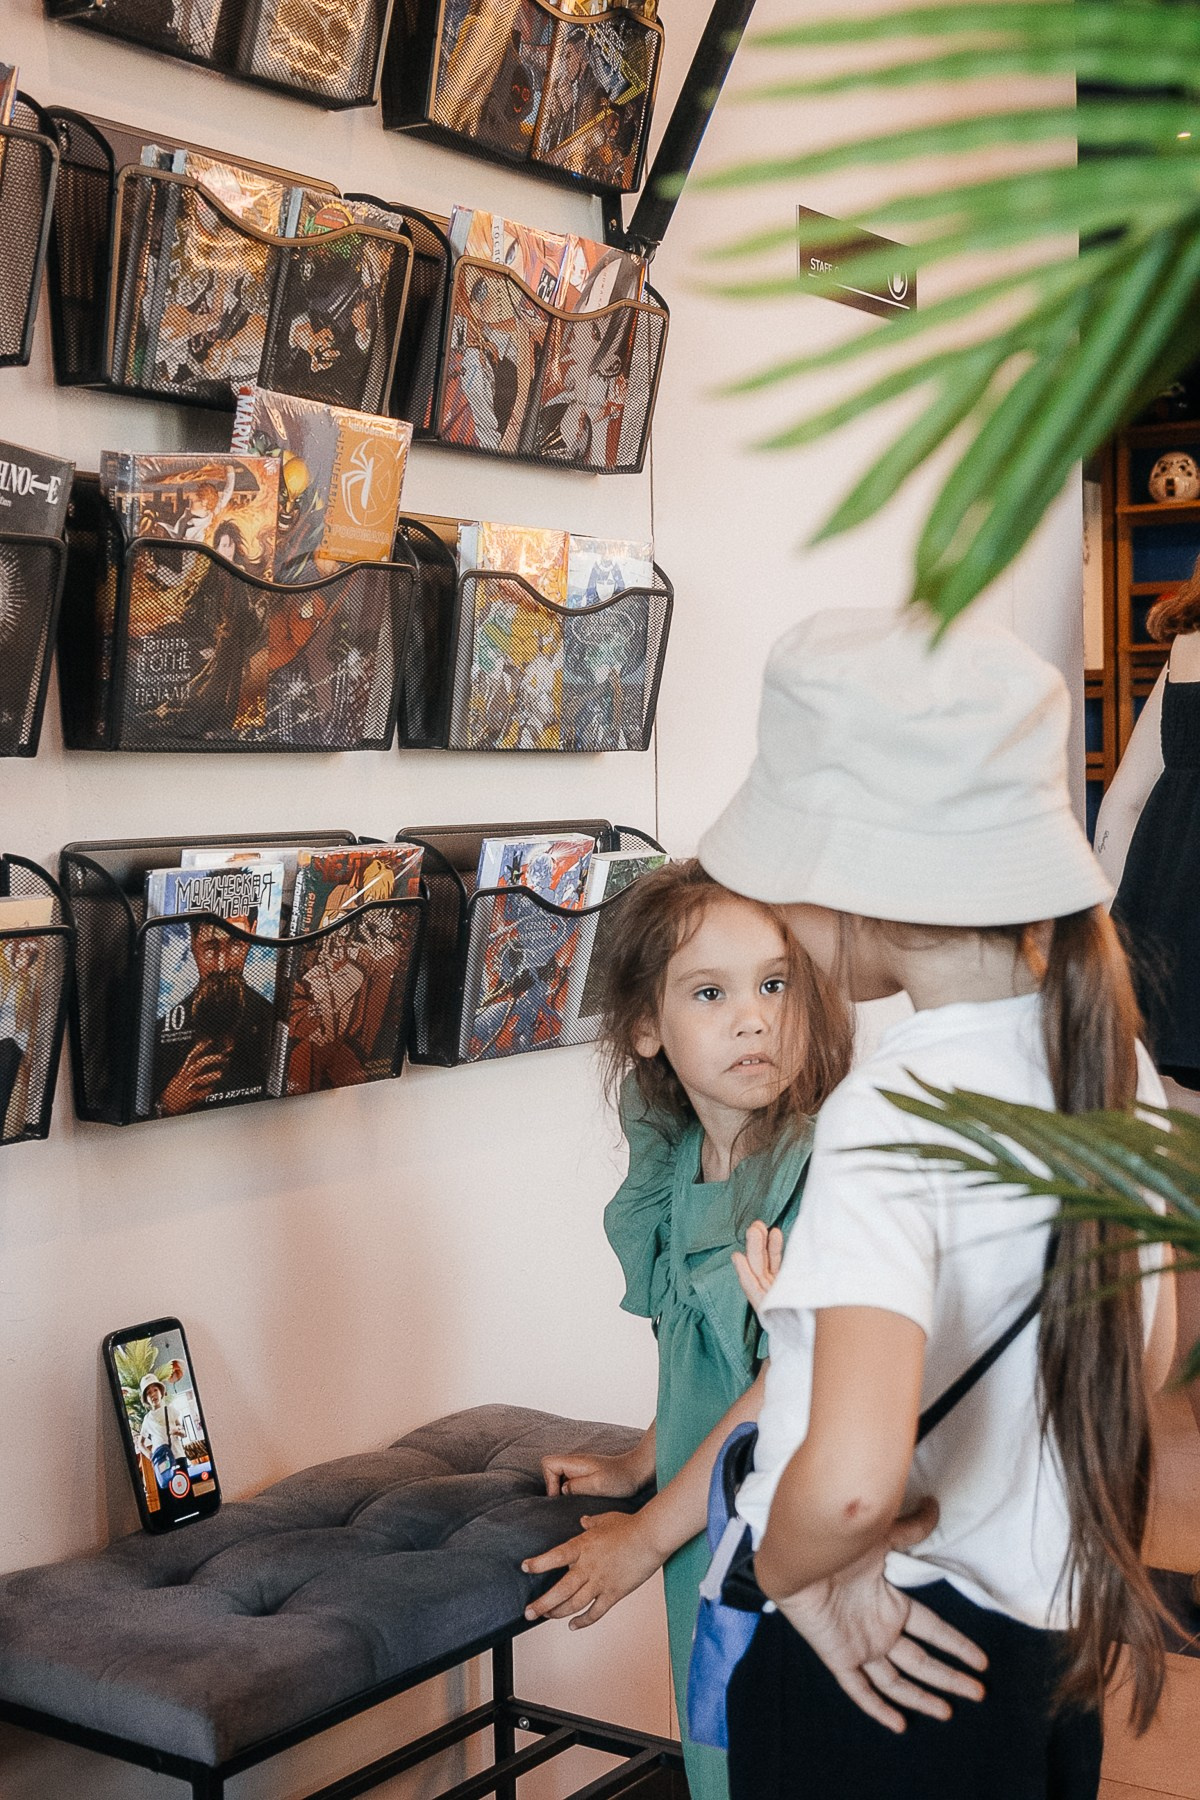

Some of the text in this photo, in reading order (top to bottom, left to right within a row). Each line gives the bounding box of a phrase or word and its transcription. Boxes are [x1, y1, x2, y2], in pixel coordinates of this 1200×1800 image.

[810, 257, 832, 272] STAFF
[230, 394, 256, 454] MARV
[175, 870, 276, 914] МАГИЧЕСКАЯ
[162, 1004, 186, 1031] 10
